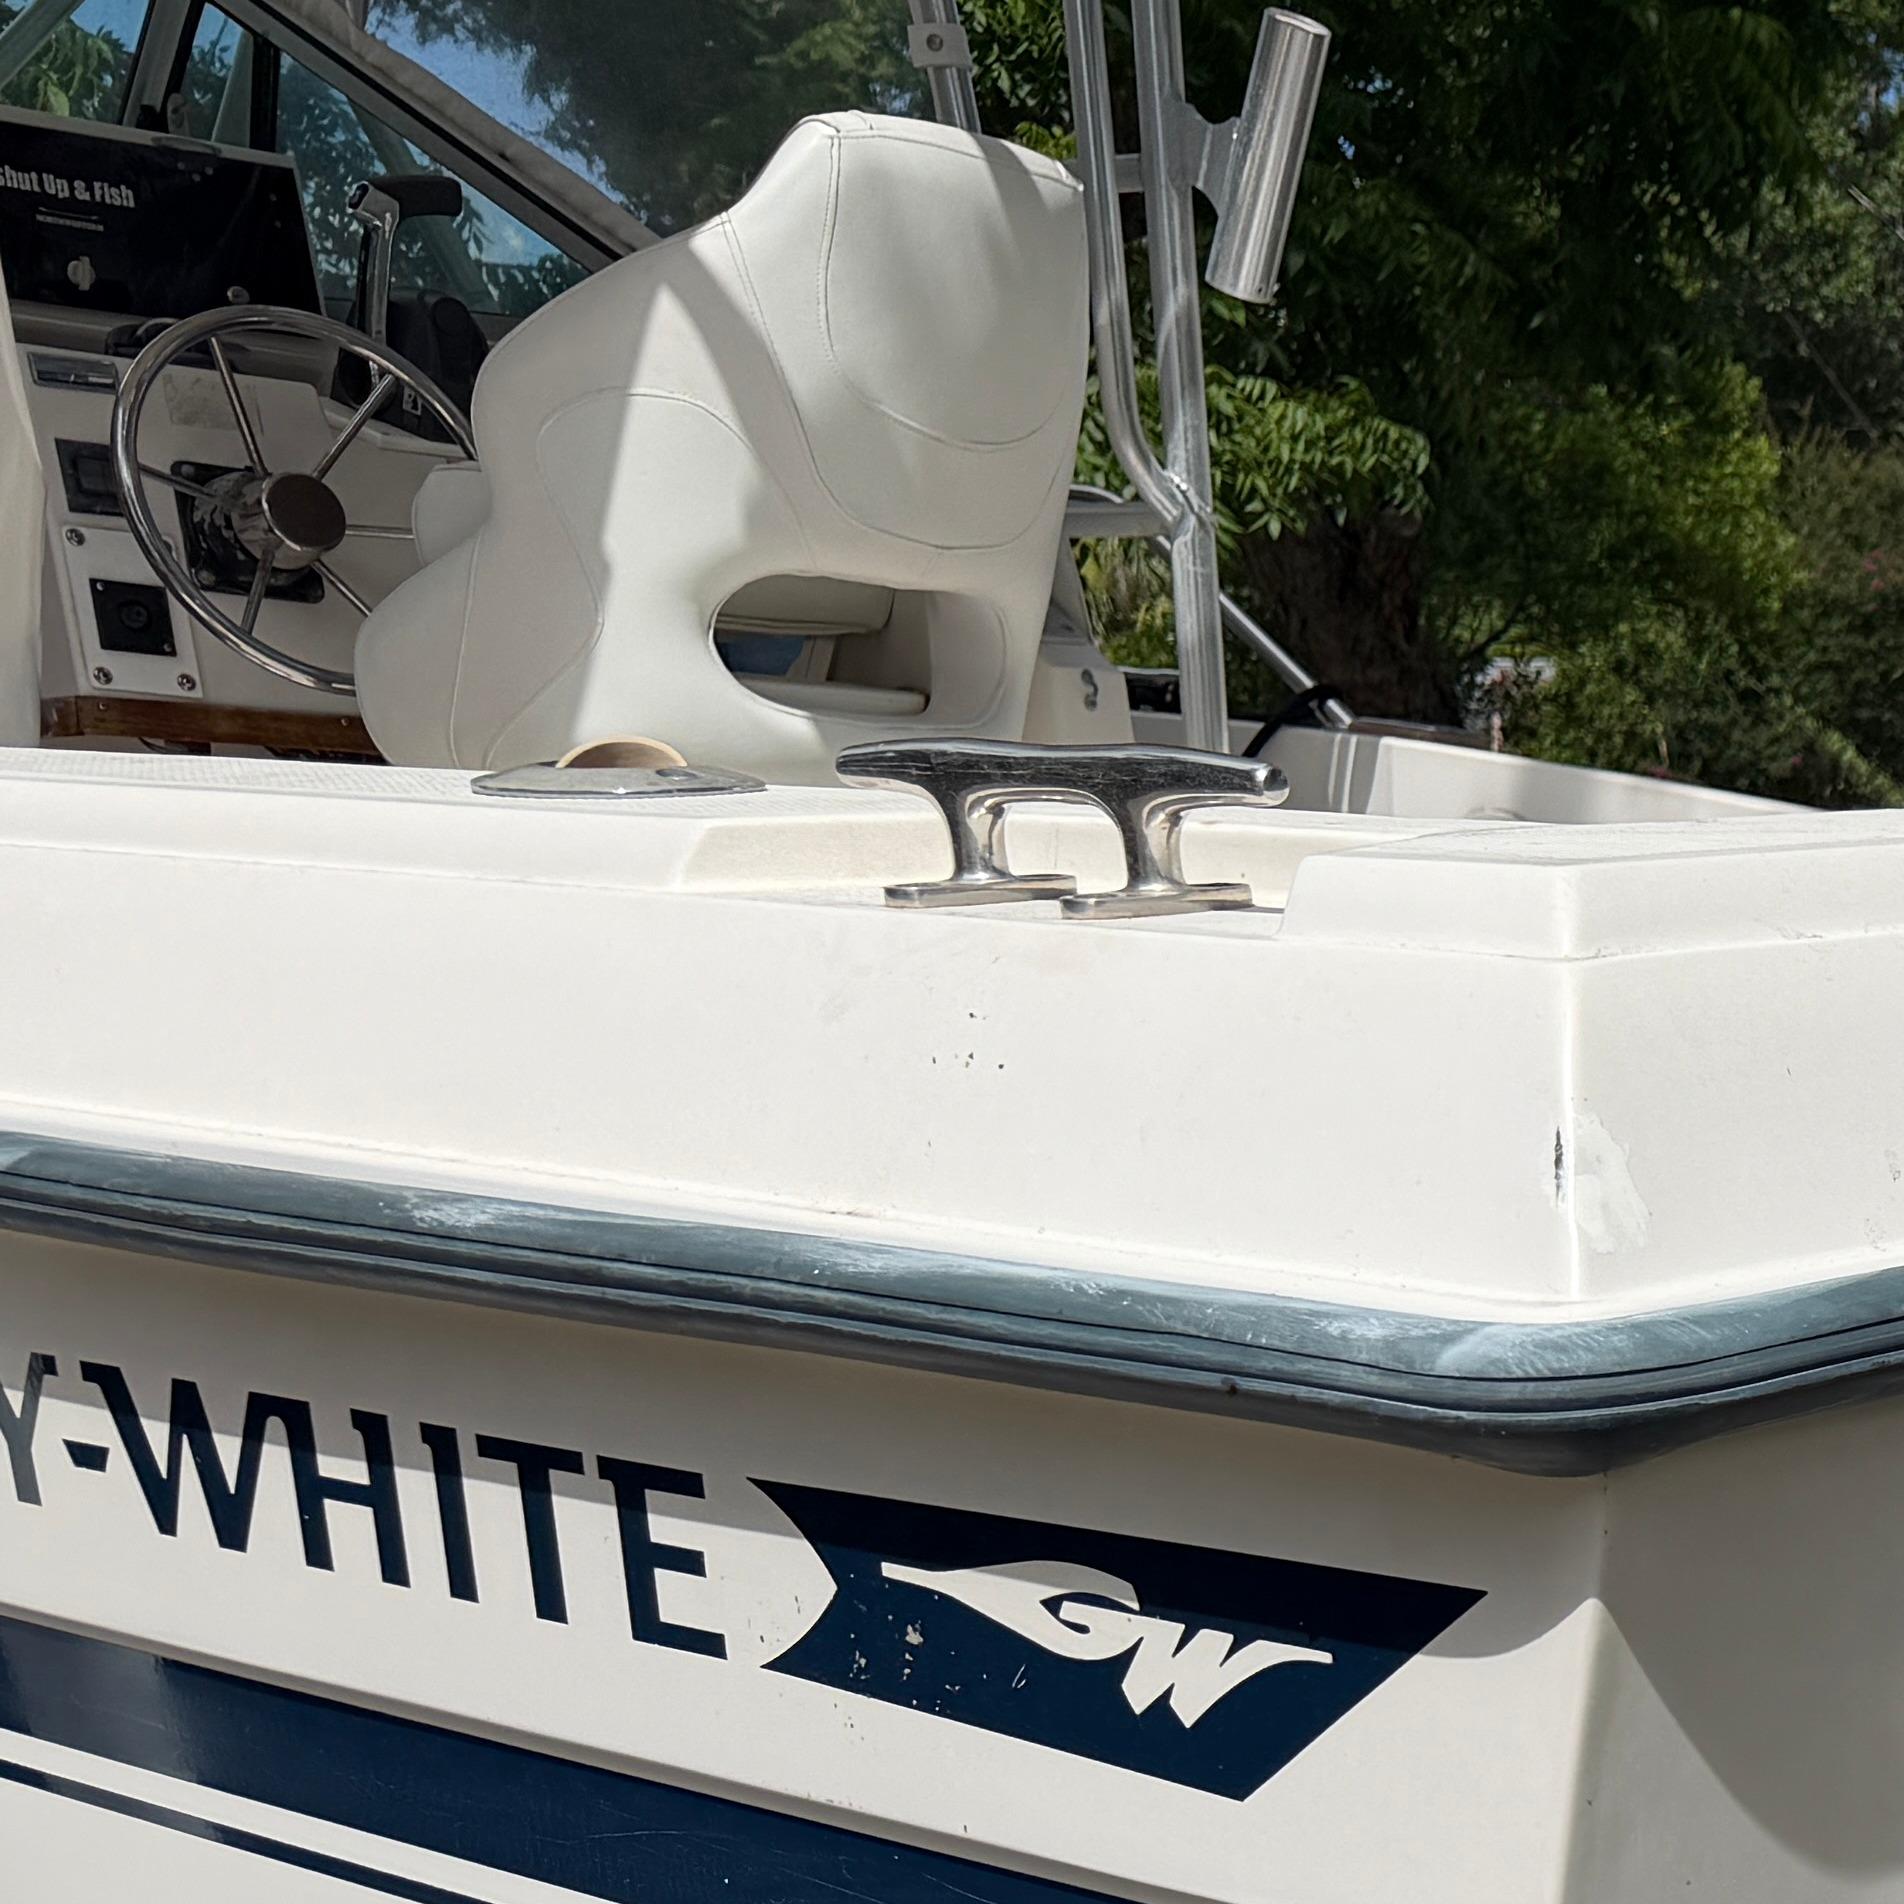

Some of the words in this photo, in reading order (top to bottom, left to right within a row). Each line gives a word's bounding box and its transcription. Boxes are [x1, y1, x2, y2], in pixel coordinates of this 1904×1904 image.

[42, 172, 70, 199] Up
[73, 179, 91, 201] &
[93, 181, 135, 208] Fish
[880, 1559, 1334, 1729] GW
